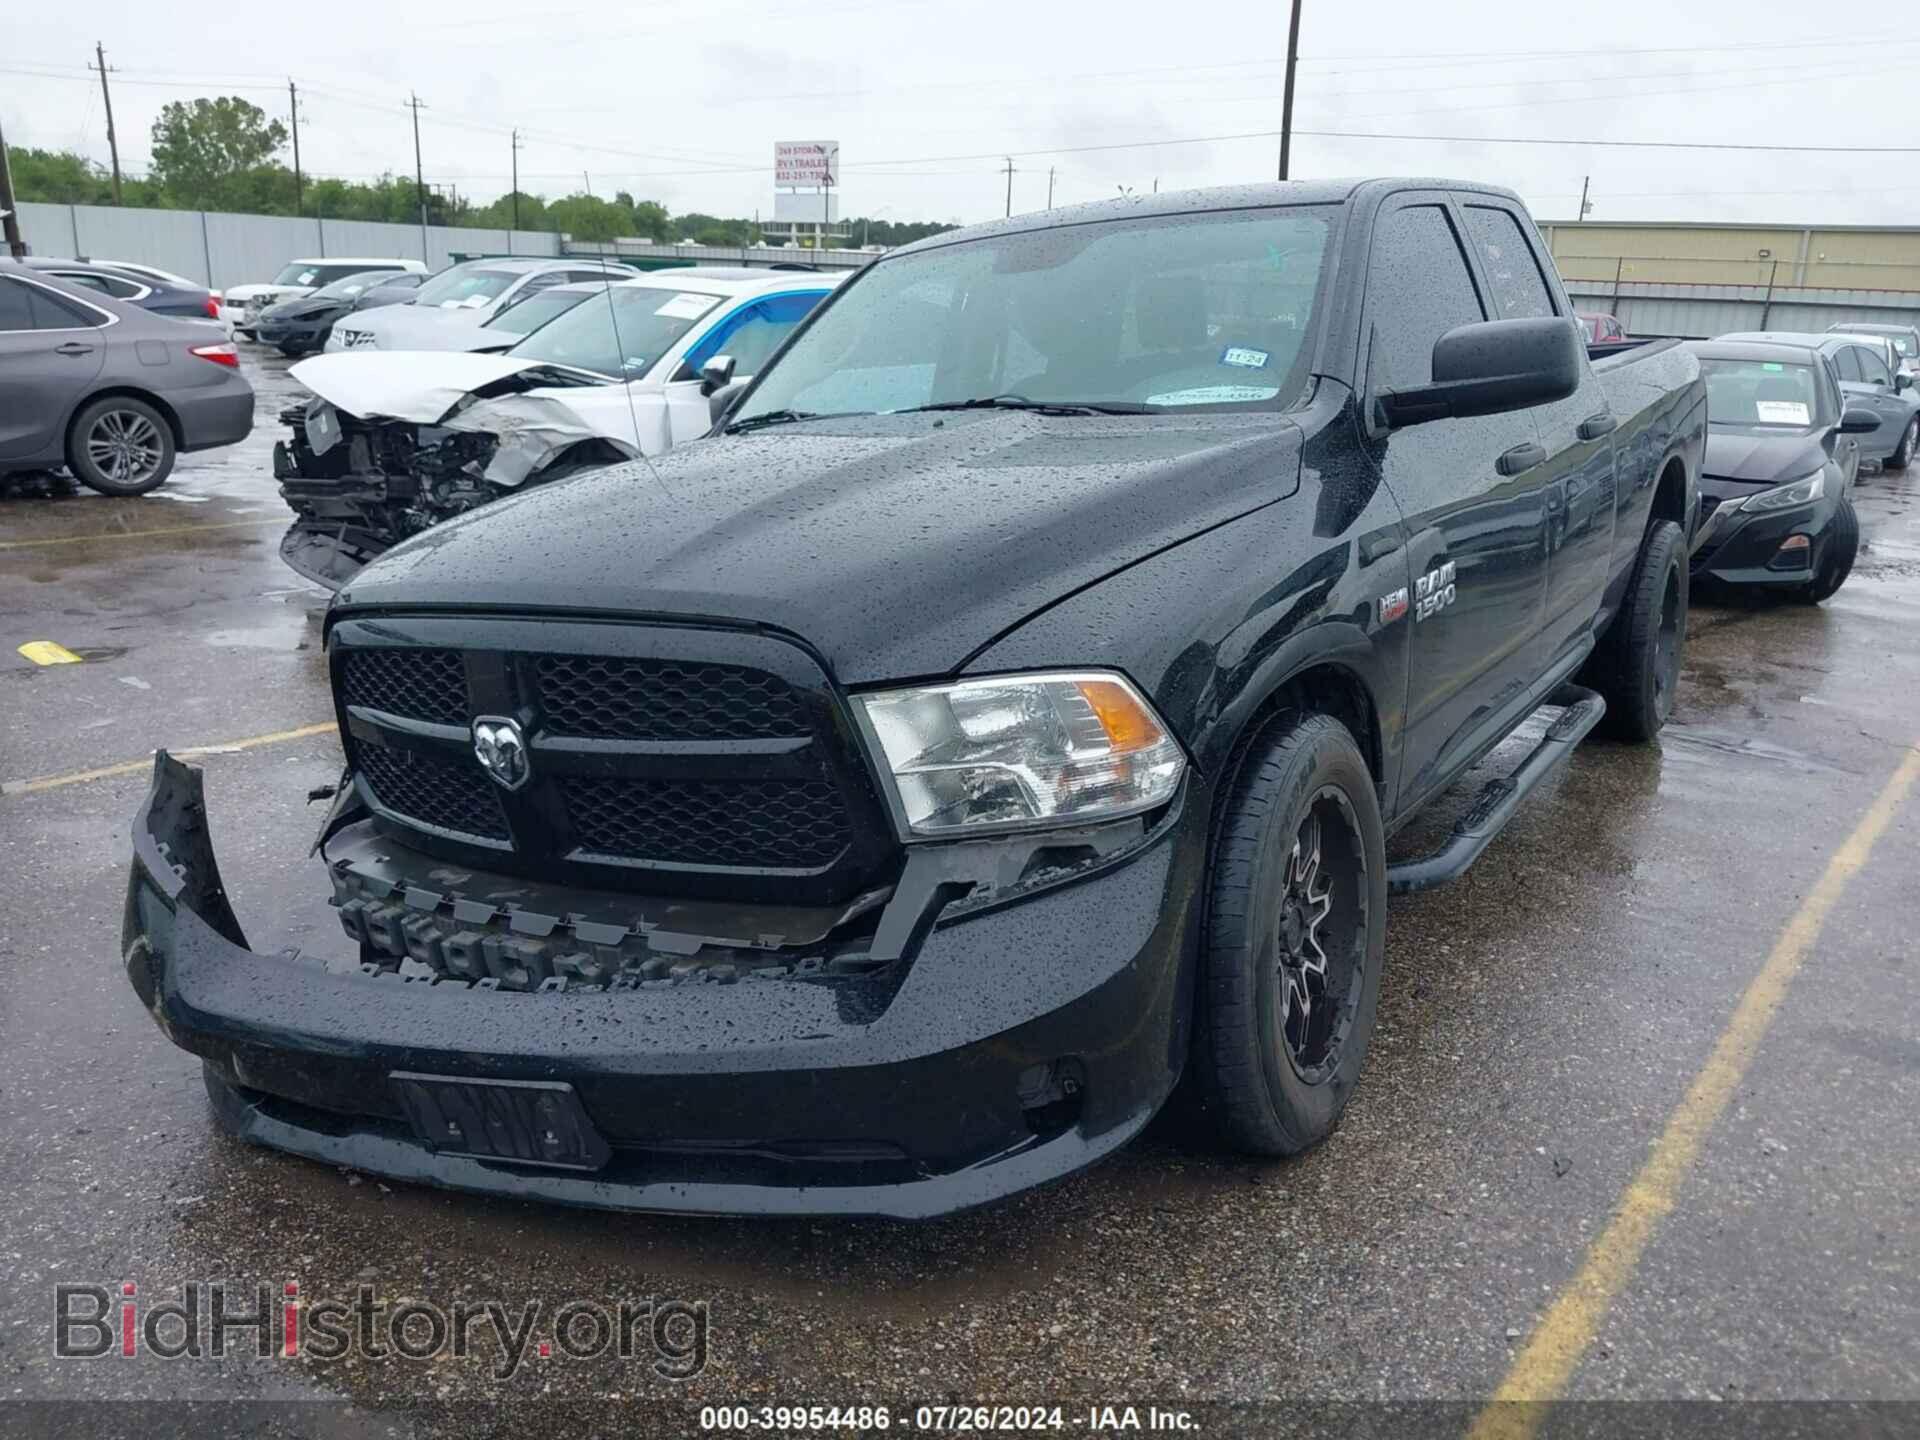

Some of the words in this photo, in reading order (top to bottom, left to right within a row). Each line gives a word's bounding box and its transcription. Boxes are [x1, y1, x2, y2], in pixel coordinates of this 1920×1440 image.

[1380, 587, 1408, 613] HEMI
[1416, 561, 1456, 600] RAM
[1416, 583, 1456, 623] 1500
